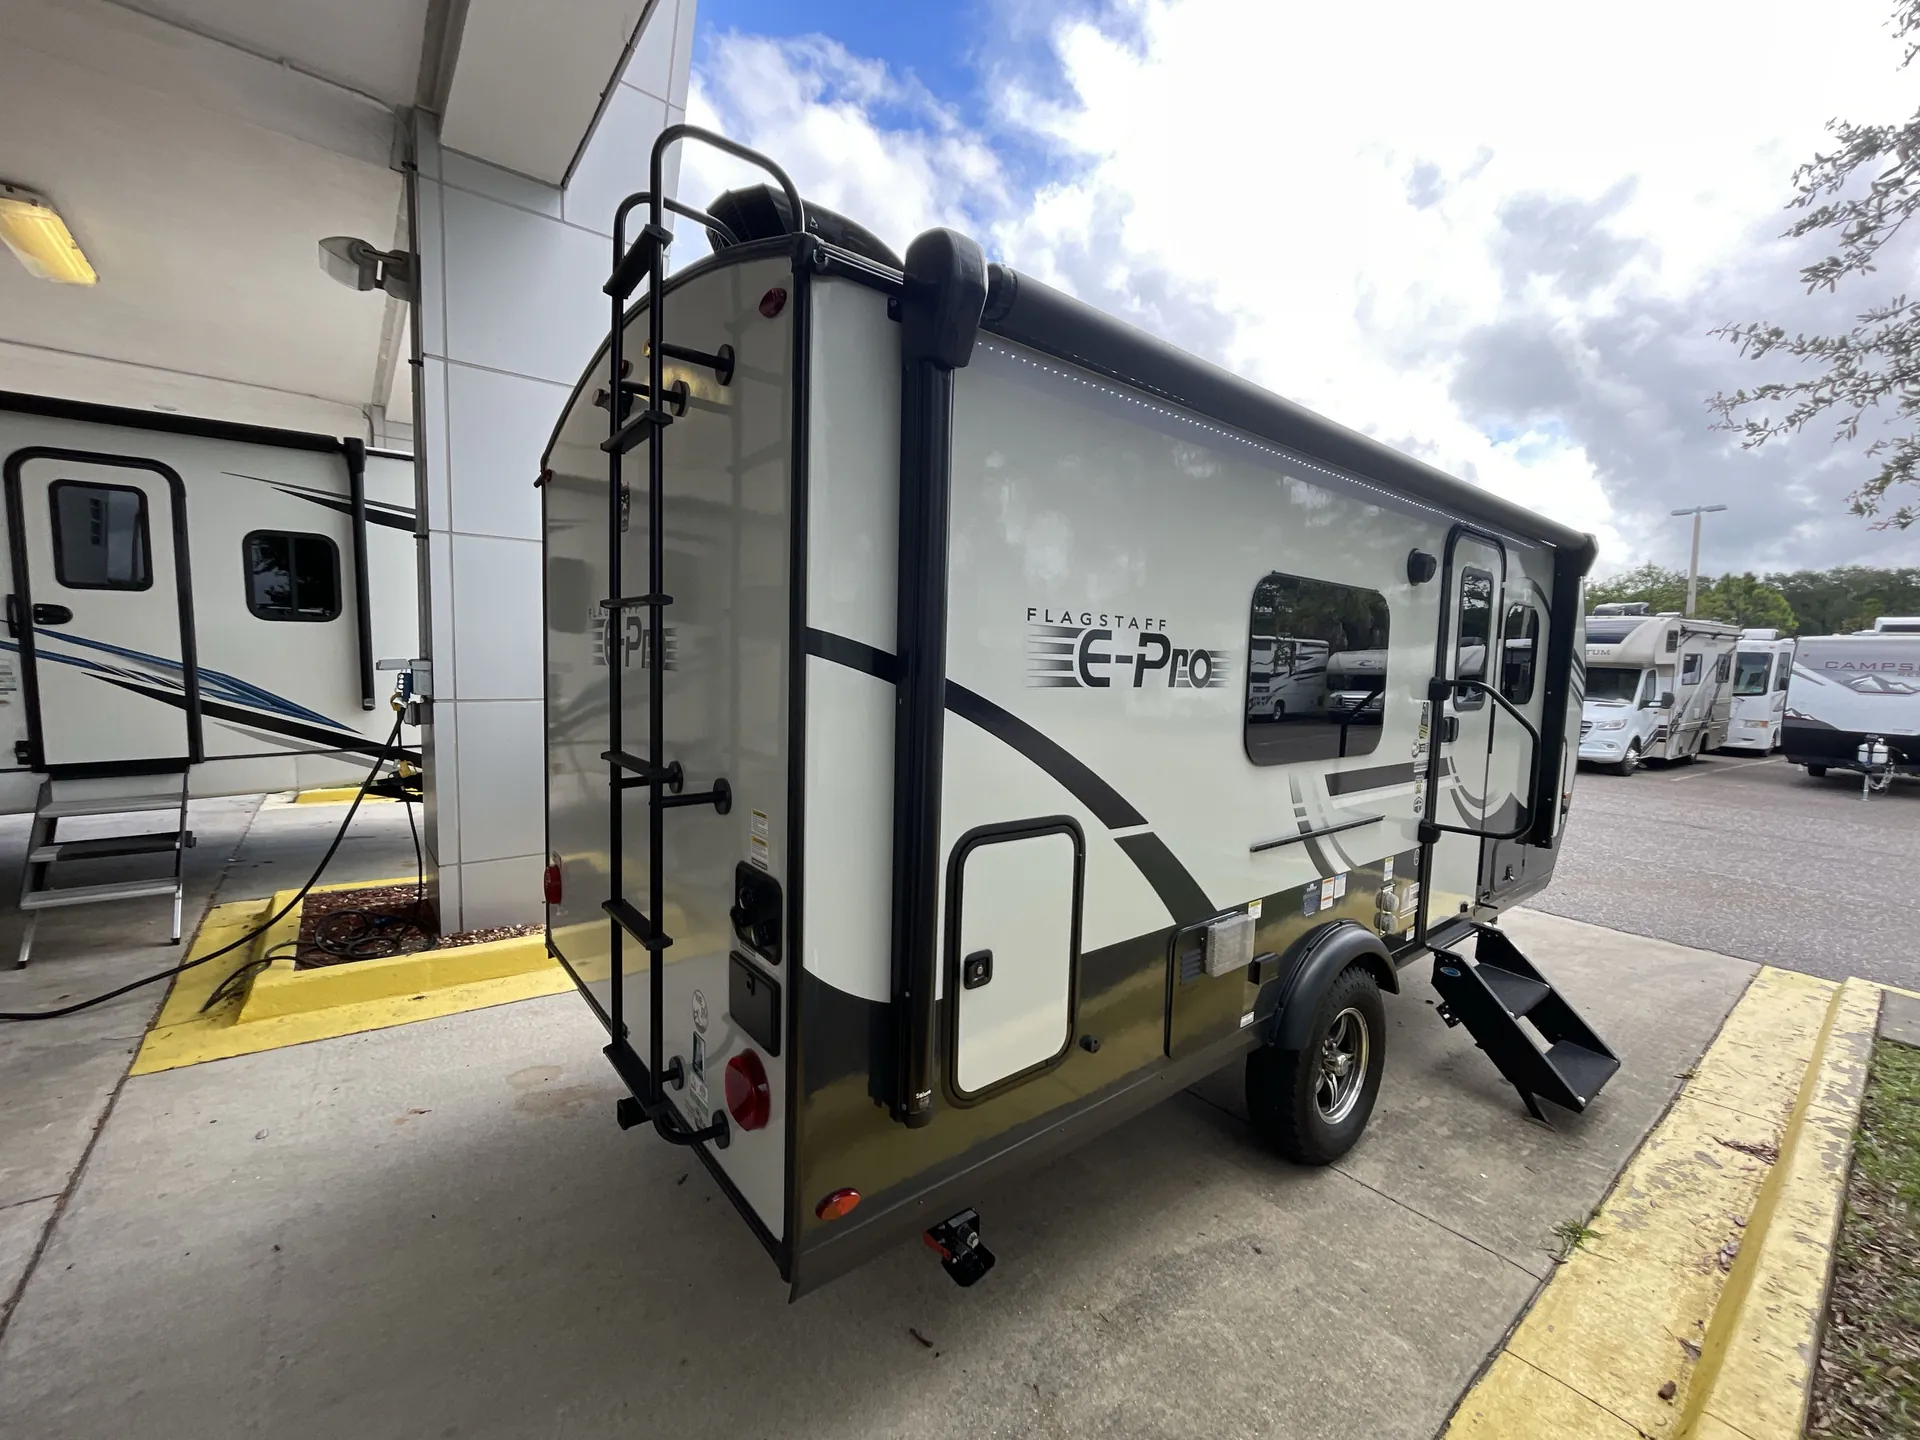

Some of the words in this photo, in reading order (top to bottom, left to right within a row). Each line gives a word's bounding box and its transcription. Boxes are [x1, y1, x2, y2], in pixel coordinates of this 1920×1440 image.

[1027, 607, 1167, 631] FLAGSTAFF
[1078, 629, 1212, 689] E-Pro
[1825, 661, 1920, 671] CAMPS
